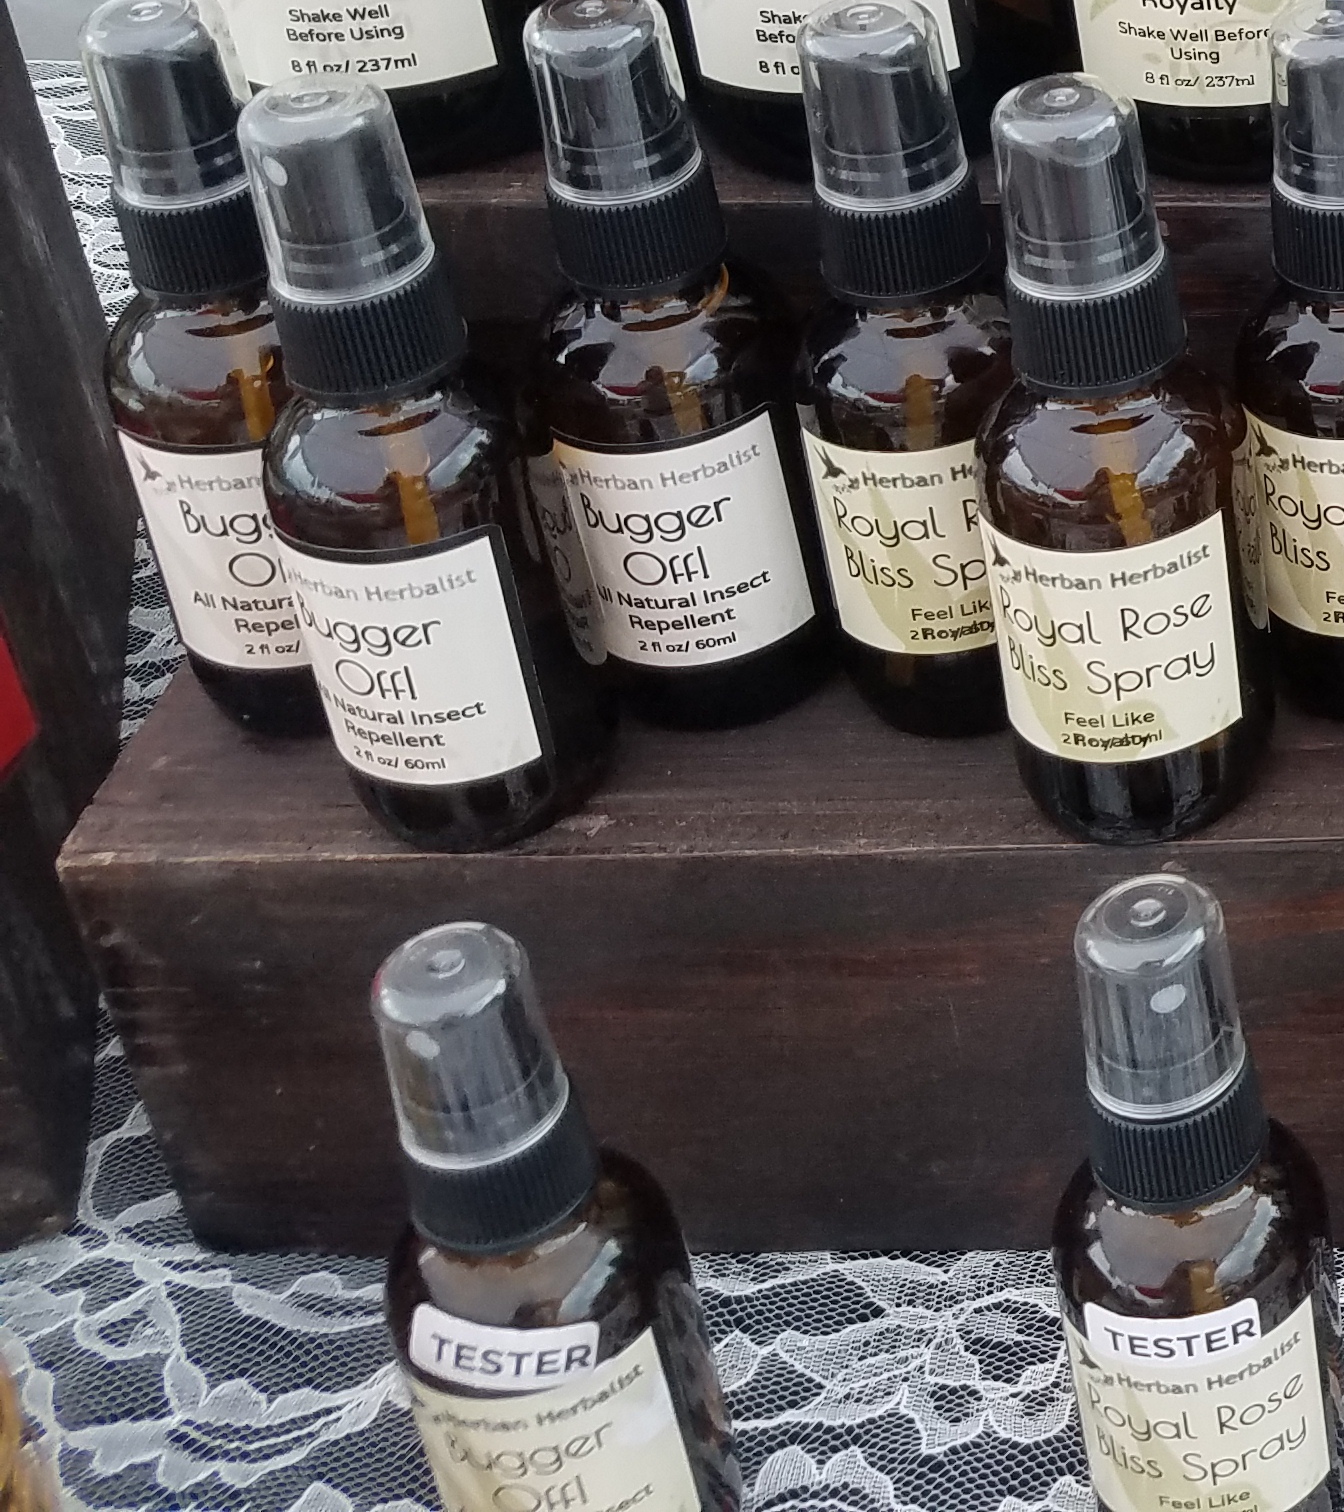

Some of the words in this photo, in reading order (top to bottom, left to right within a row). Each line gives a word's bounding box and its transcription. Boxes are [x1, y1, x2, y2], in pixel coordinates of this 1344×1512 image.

[286, 27, 344, 42] Before
[350, 24, 405, 41] Using
[288, 8, 343, 23] Shake
[346, 4, 389, 20] Well
[579, 468, 653, 491] Herban
[660, 444, 760, 488] Herbalist
[580, 492, 731, 543] Bugger
[629, 608, 736, 635] Repellent
[1000, 585, 1102, 647] Royal
[1120, 593, 1212, 642] Rose
[1008, 636, 1068, 692] Bliss
[1086, 642, 1215, 700] Spray
[431, 1333, 591, 1377] TESTER
[1104, 1318, 1258, 1358] TESTER
[1217, 1374, 1303, 1435] Rose
[1182, 1415, 1307, 1486] Spray
